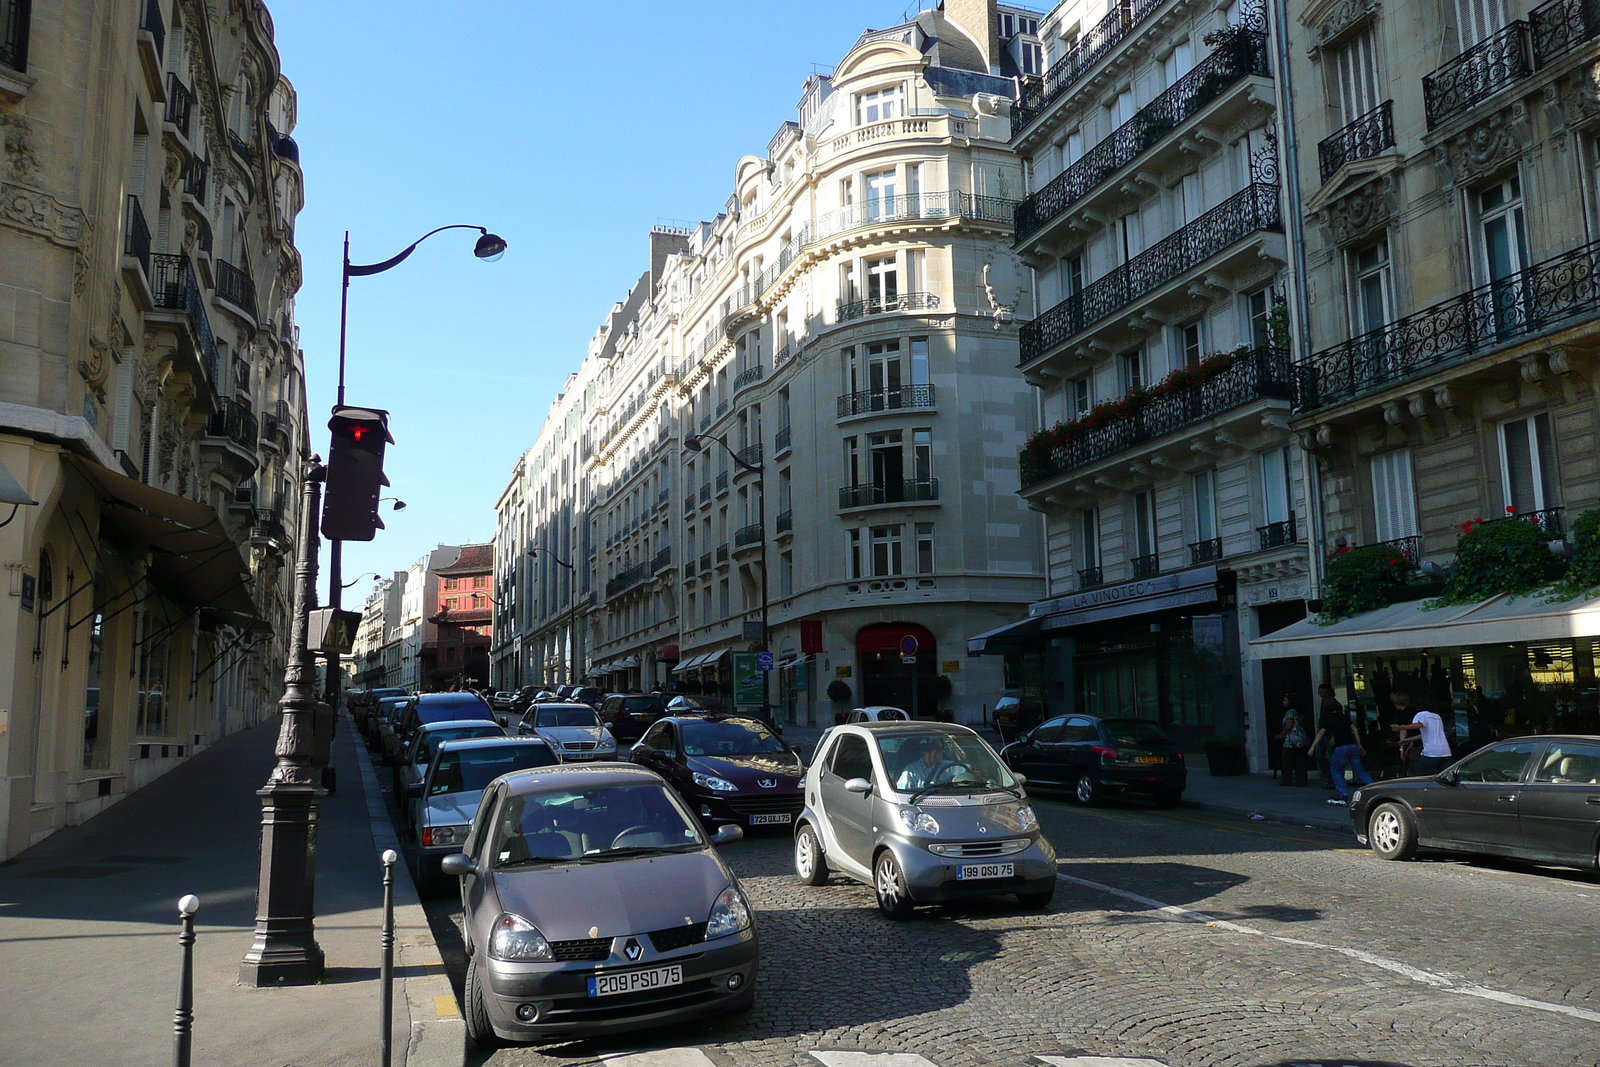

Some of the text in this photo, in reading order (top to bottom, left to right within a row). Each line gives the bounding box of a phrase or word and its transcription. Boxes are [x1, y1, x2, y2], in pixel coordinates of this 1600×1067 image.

[1073, 595, 1088, 607] LA
[884, 710, 899, 720] 32
[754, 815, 767, 823] 729
[781, 814, 790, 822] 75
[963, 864, 1013, 878] 199 QSQ 75
[599, 975, 628, 994] 209
[631, 971, 659, 990] PSD
[661, 967, 680, 984] 75
